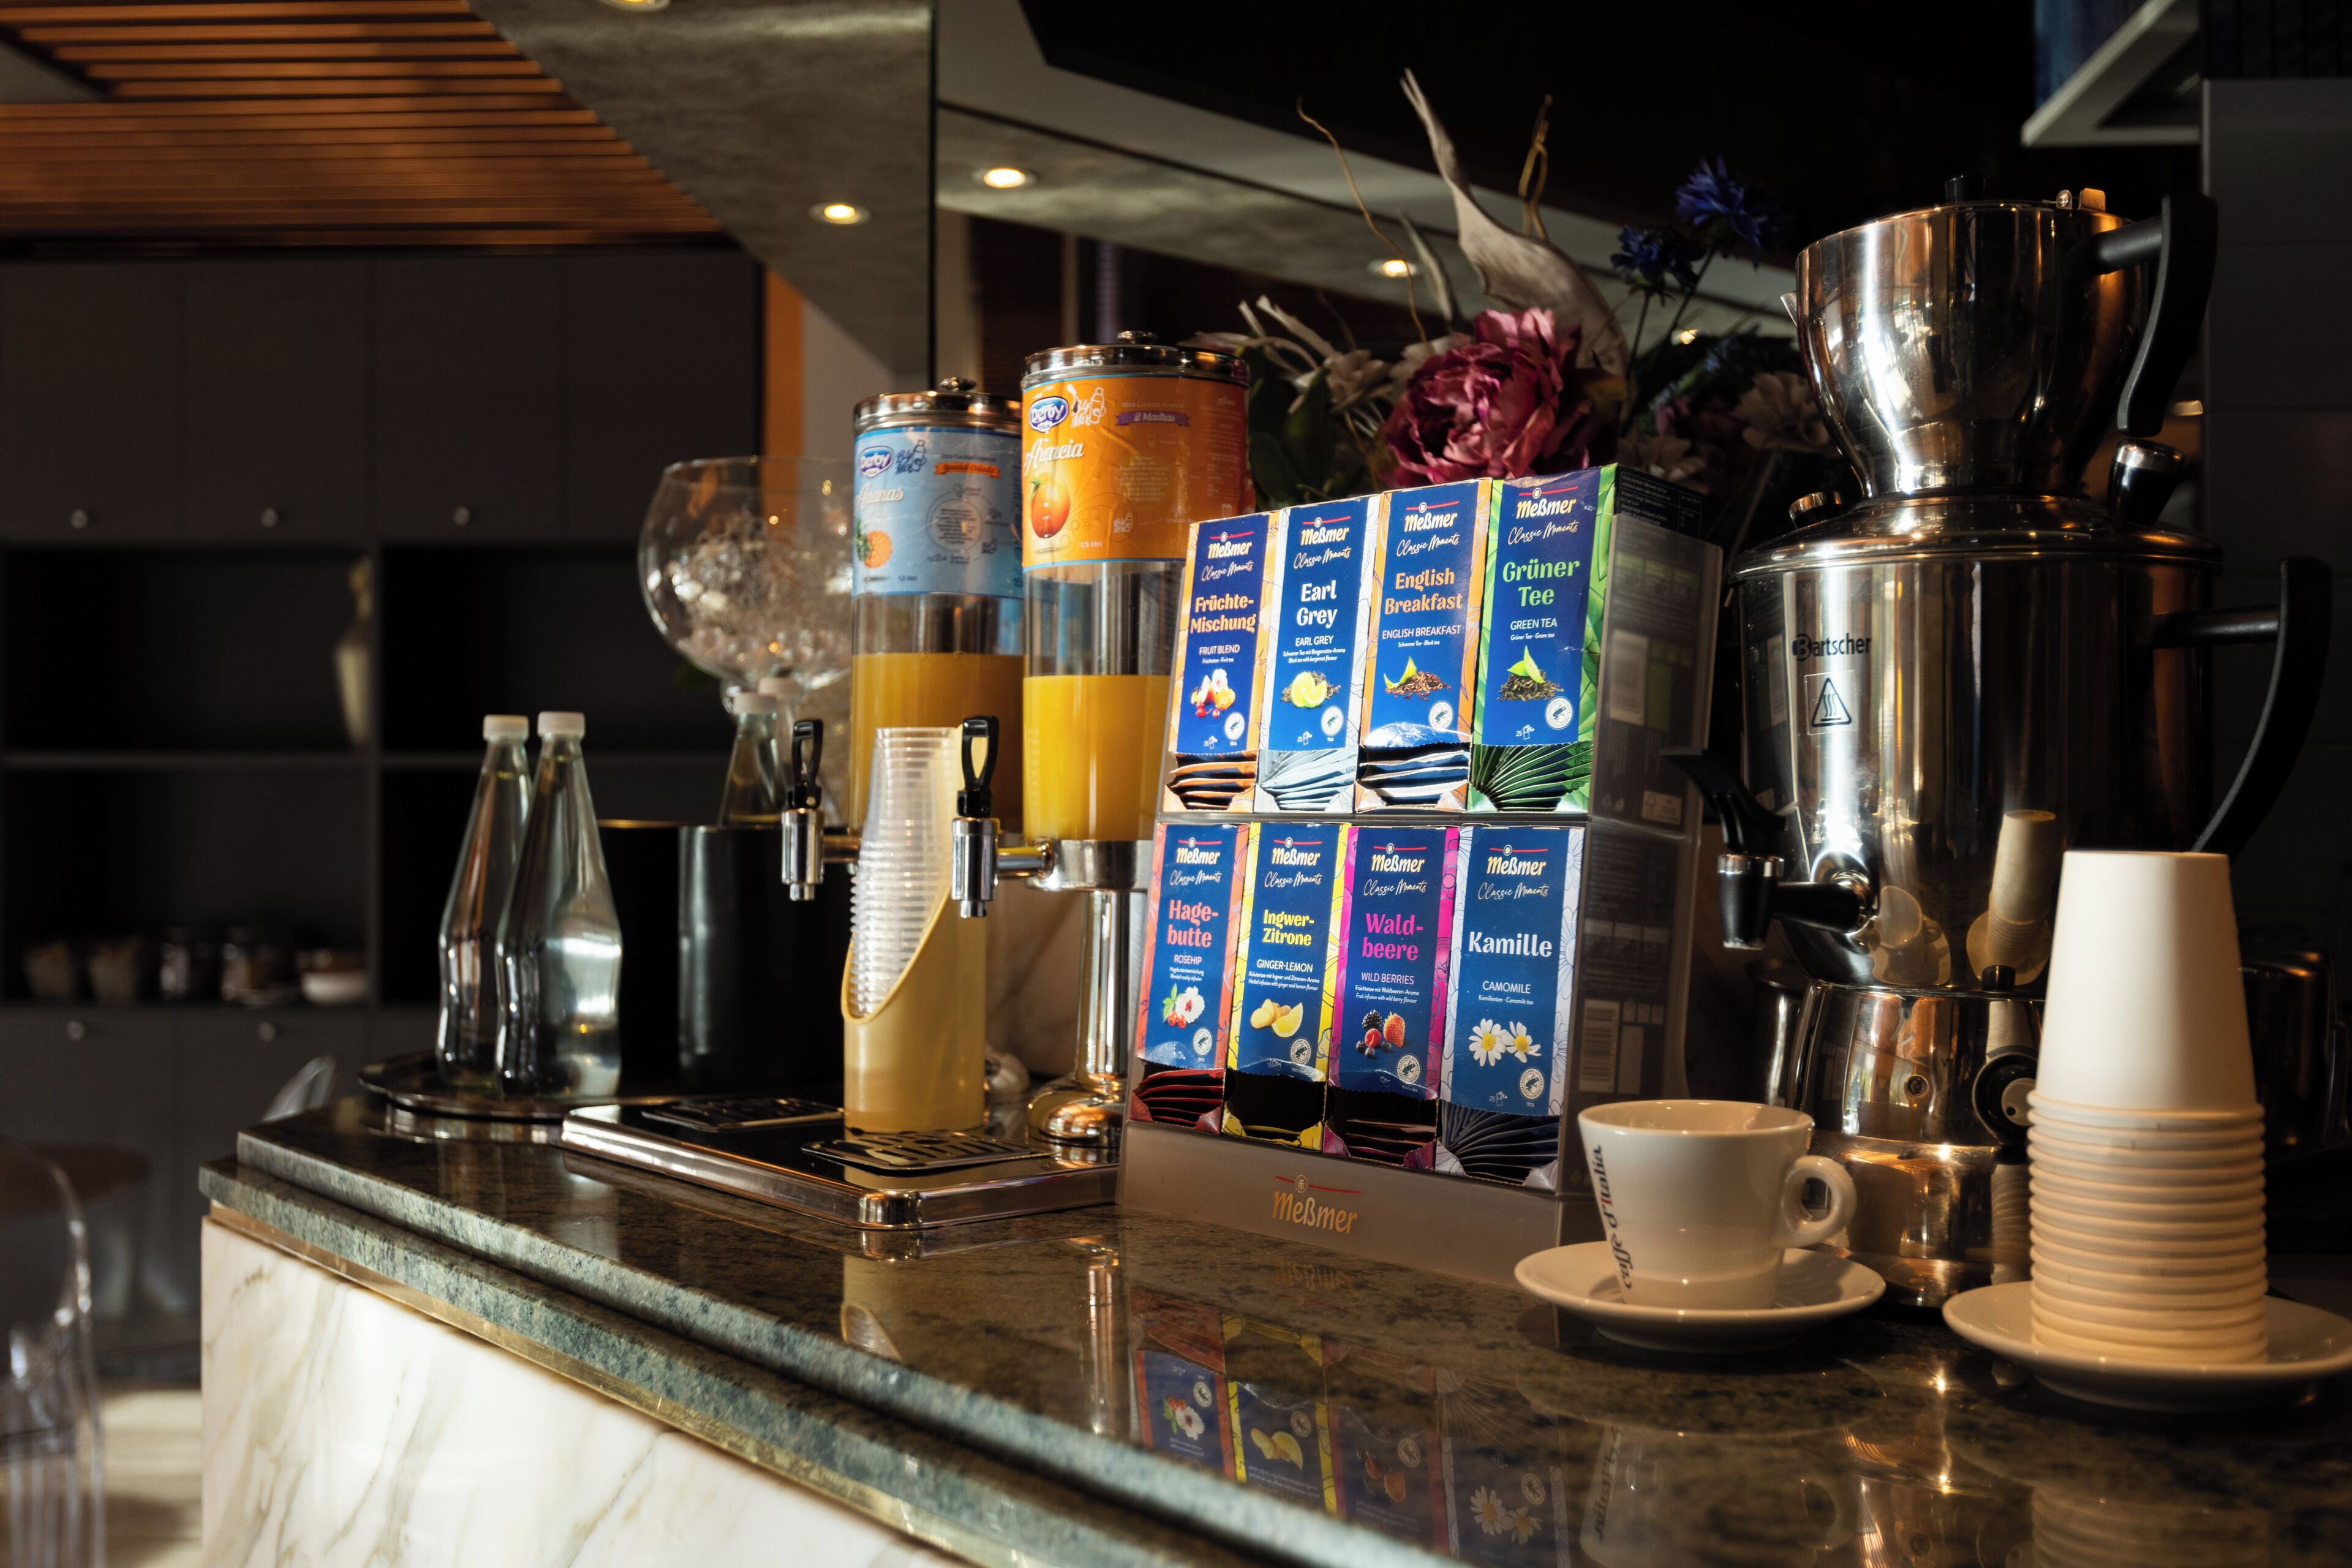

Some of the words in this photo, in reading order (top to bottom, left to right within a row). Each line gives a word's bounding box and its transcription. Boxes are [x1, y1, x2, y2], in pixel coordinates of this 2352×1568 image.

[1031, 404, 1064, 422] Derby
[1142, 412, 1175, 422] Madras
[861, 453, 891, 469] Derby
[1024, 438, 1084, 477] Arancia
[854, 482, 905, 510] Ananas
[1516, 497, 1577, 519] Meßmer
[1404, 511, 1458, 532] Meßmer
[1300, 527, 1349, 546] Meßmer
[1507, 527, 1542, 546] Classic
[1542, 519, 1578, 539] Moments
[1208, 541, 1253, 559] Meßmer
[1396, 539, 1428, 557] Classic
[1428, 535, 1460, 551] Moments
[1293, 552, 1322, 570] Classic
[1322, 546, 1351, 564] Moments
[1201, 565, 1227, 581] Classic
[1227, 560, 1253, 577] Moments
[1395, 568, 1455, 592] English
[1502, 558, 1581, 583] Grüner
[1300, 580, 1337, 602] Earl
[1518, 586, 1555, 607] Tee
[1194, 593, 1254, 612] Früchte-
[1384, 593, 1463, 615] Breakfast
[1190, 613, 1256, 633] Mischung
[1297, 607, 1338, 629] Grey
[1510, 619, 1540, 630] GREEN
[1540, 617, 1558, 628] TEA
[1295, 637, 1313, 647] EARL
[1313, 635, 1334, 646] GREY
[1382, 628, 1414, 639] ENGLISH
[1415, 625, 1461, 637] BREAKFAST
[1199, 646, 1218, 655] FRUIT
[1218, 644, 1240, 654] BLEND
[1792, 633, 1872, 662] Bartscher
[1176, 847, 1220, 865] Meßmer
[1272, 848, 1321, 866] Meßmer
[1371, 854, 1425, 873] Meßmer
[1487, 856, 1547, 876] Meßmer
[1169, 870, 1196, 886] Classic
[1196, 869, 1222, 883] Moments
[1264, 872, 1294, 888] Classic
[1294, 872, 1322, 887] Moments
[1363, 879, 1395, 896] Classic
[1395, 878, 1427, 894] Moments
[1477, 881, 1513, 900] Classic
[1513, 881, 1550, 899] Moments
[1169, 899, 1219, 927] Hage-
[1264, 910, 1314, 929] Ingwer-
[1365, 913, 1423, 936] Wald-
[1167, 924, 1212, 948] butte
[1262, 927, 1312, 946] Zitrone
[1469, 931, 1553, 957] Kamille
[1362, 936, 1419, 960] beere
[1174, 954, 1202, 965] ROSEHIP
[1256, 959, 1313, 973] GINGER-LEMON
[1361, 972, 1380, 982] WILD
[1381, 973, 1414, 985] BERRIES
[1482, 981, 1531, 993] CAMOMILE
[1272, 1190, 1358, 1234] Meßmer
